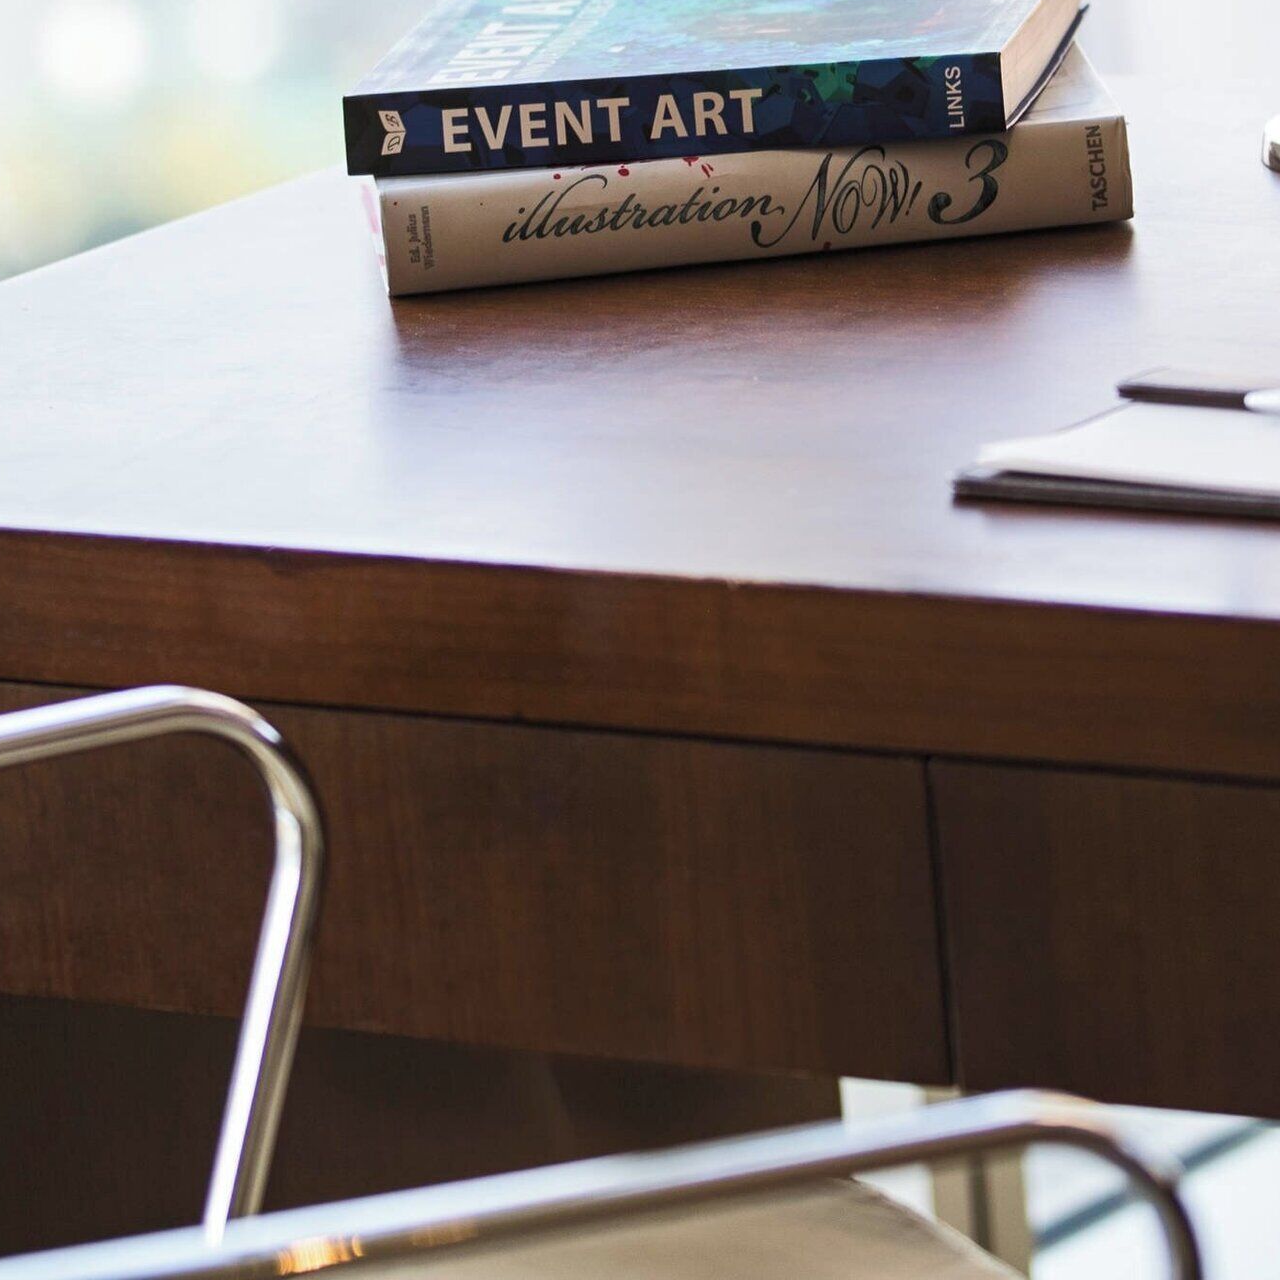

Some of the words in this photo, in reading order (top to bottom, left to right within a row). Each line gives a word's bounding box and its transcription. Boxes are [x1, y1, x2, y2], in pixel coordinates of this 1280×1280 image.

[427, 21, 562, 84] EVENT
[441, 96, 631, 154] EVENT
[650, 88, 763, 140] ART
[944, 65, 965, 129] LINKS
[501, 173, 785, 244] illustration
[927, 138, 1009, 225] 3
[1084, 124, 1109, 213] TASCHEN
